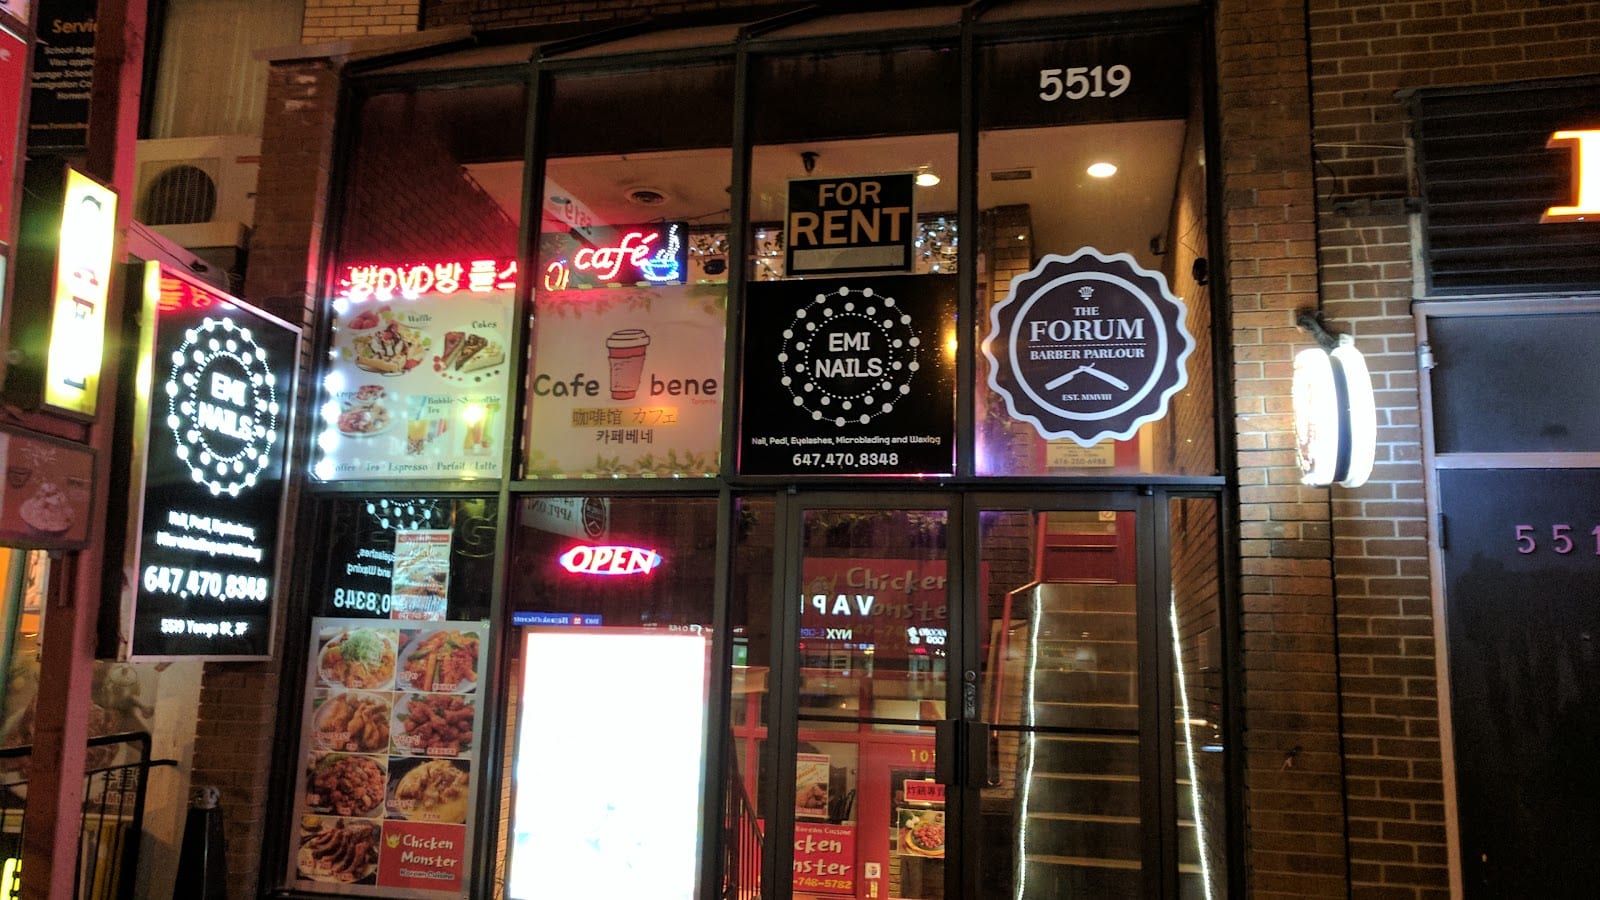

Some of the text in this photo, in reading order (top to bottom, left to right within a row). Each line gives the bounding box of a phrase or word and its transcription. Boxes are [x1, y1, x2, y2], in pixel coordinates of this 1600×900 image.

[1040, 64, 1131, 101] 5519
[818, 181, 882, 207] FOR
[789, 206, 910, 247] RENT
[573, 232, 659, 280] café
[1072, 306, 1100, 316] THE
[471, 320, 498, 329] Cakes
[1029, 318, 1145, 342] FORUM
[828, 331, 871, 352] EMI
[1030, 348, 1145, 361] BARBER PARLOUR
[815, 357, 883, 378] NAILS
[532, 374, 718, 397] Cafe bene
[198, 401, 253, 441] NAILS
[571, 407, 624, 427] 咖啡馆
[632, 407, 677, 425] カフェ
[595, 428, 654, 445] 카페베네
[835, 436, 890, 445] Microblading
[891, 436, 908, 444] and
[792, 452, 899, 468] 647.470.8348
[566, 545, 656, 575] OPEN
[402, 833, 454, 850] Chicken
[401, 851, 459, 868] Monster
